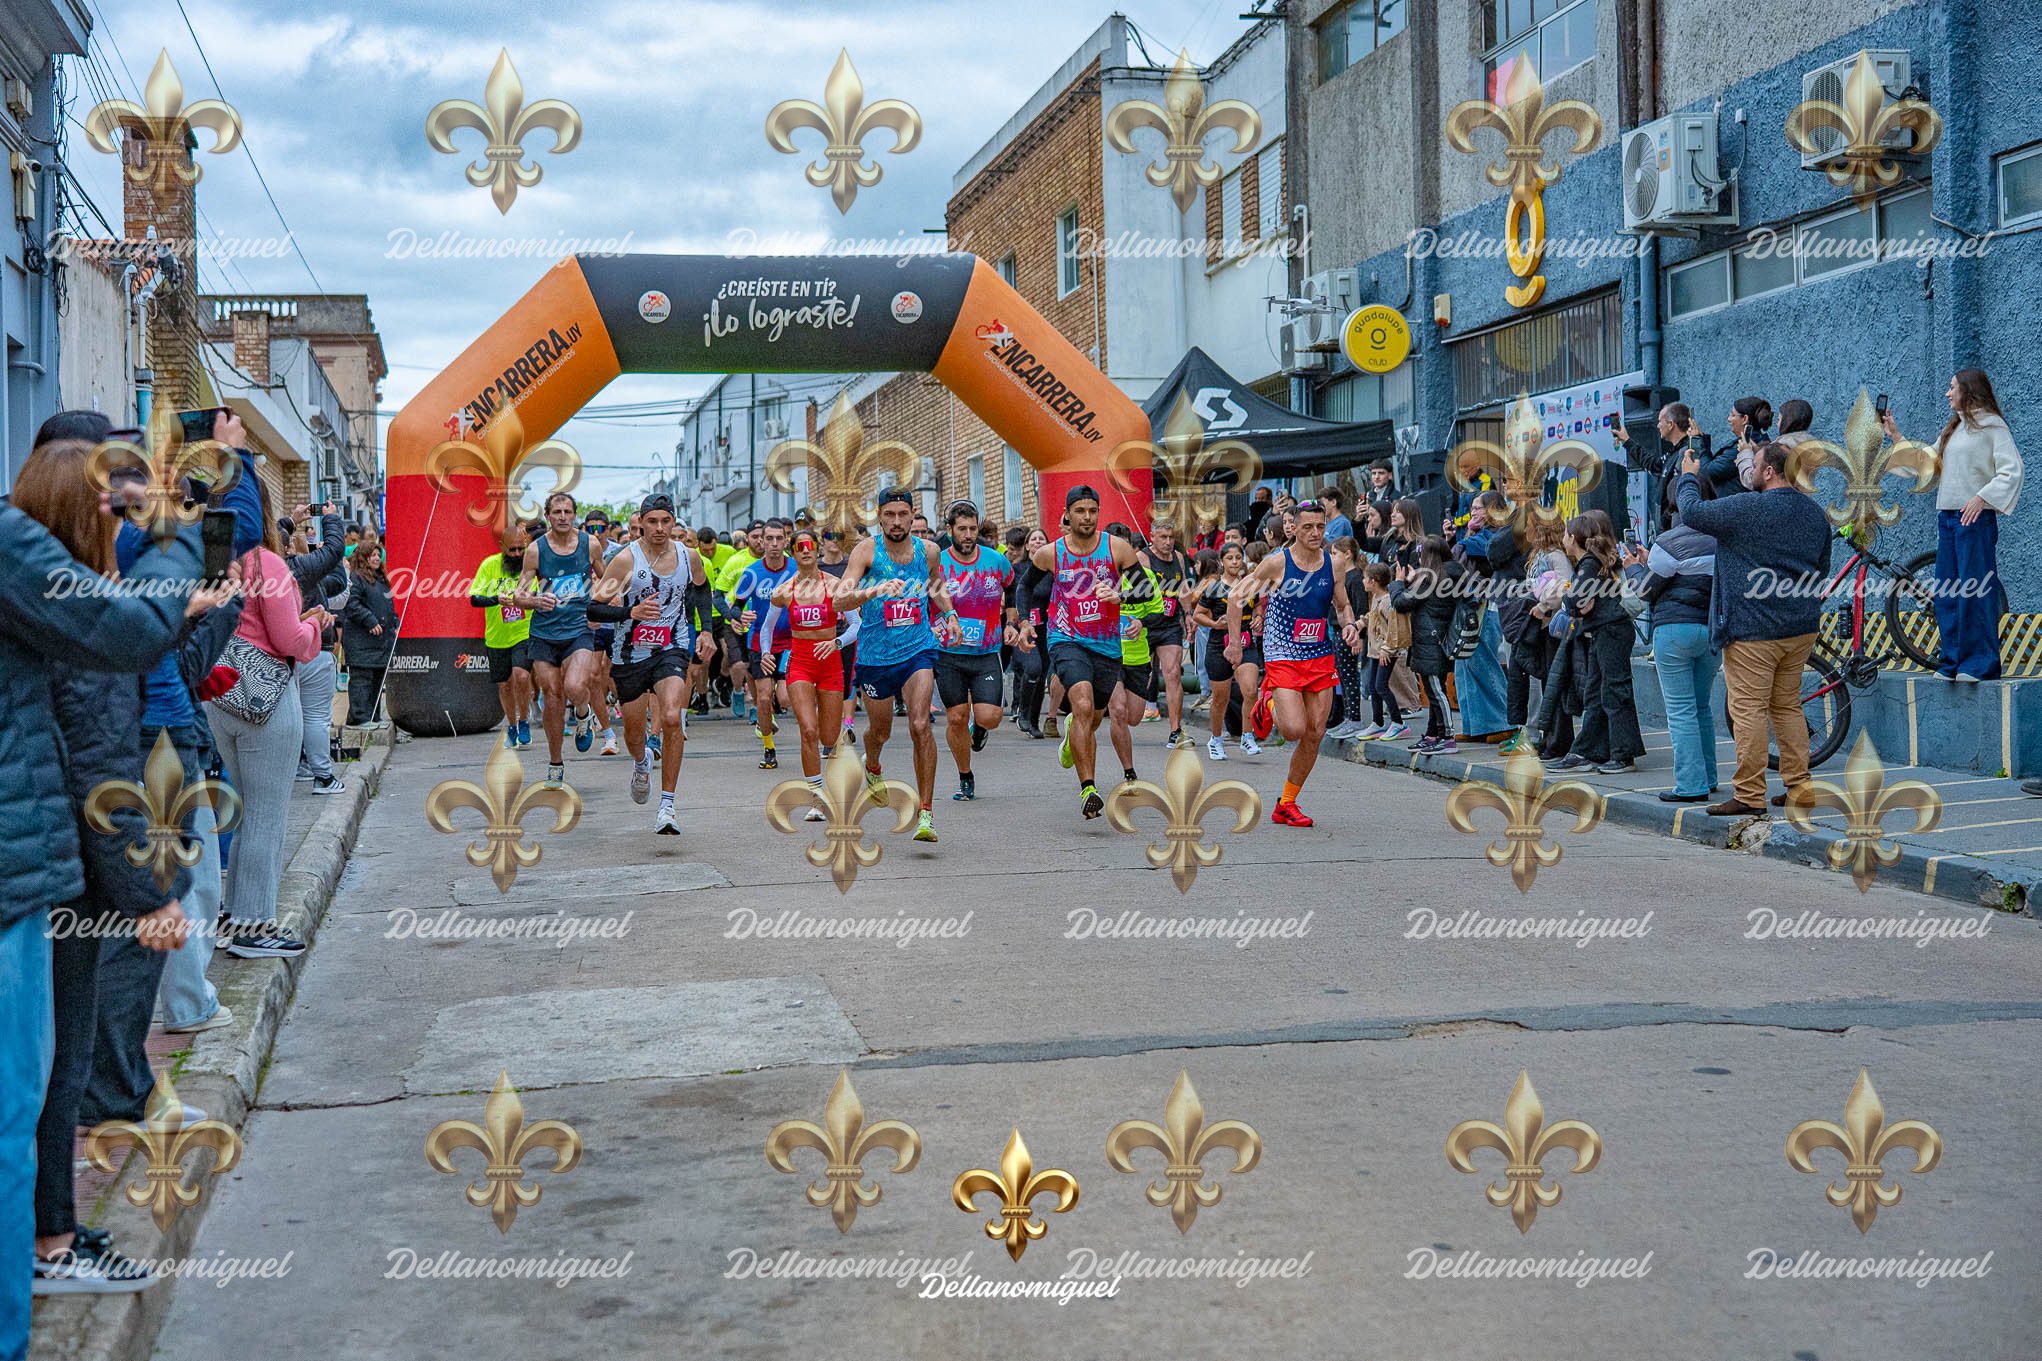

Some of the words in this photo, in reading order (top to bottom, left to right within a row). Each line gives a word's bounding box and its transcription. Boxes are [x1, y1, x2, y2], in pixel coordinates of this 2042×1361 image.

[718, 277, 788, 300] ¿CREÍSTE
[791, 280, 812, 297] EN
[814, 278, 837, 297] TÍ?
[703, 299, 740, 348] ¡Lo
[749, 294, 861, 343] lograste!
[1354, 311, 1404, 335] guadalupe
[1368, 358, 1388, 367] club
[799, 608, 820, 620] 178
[892, 603, 913, 619] 179
[1077, 600, 1099, 615] 199
[638, 628, 665, 643] 234
[1299, 622, 1321, 636] 207
